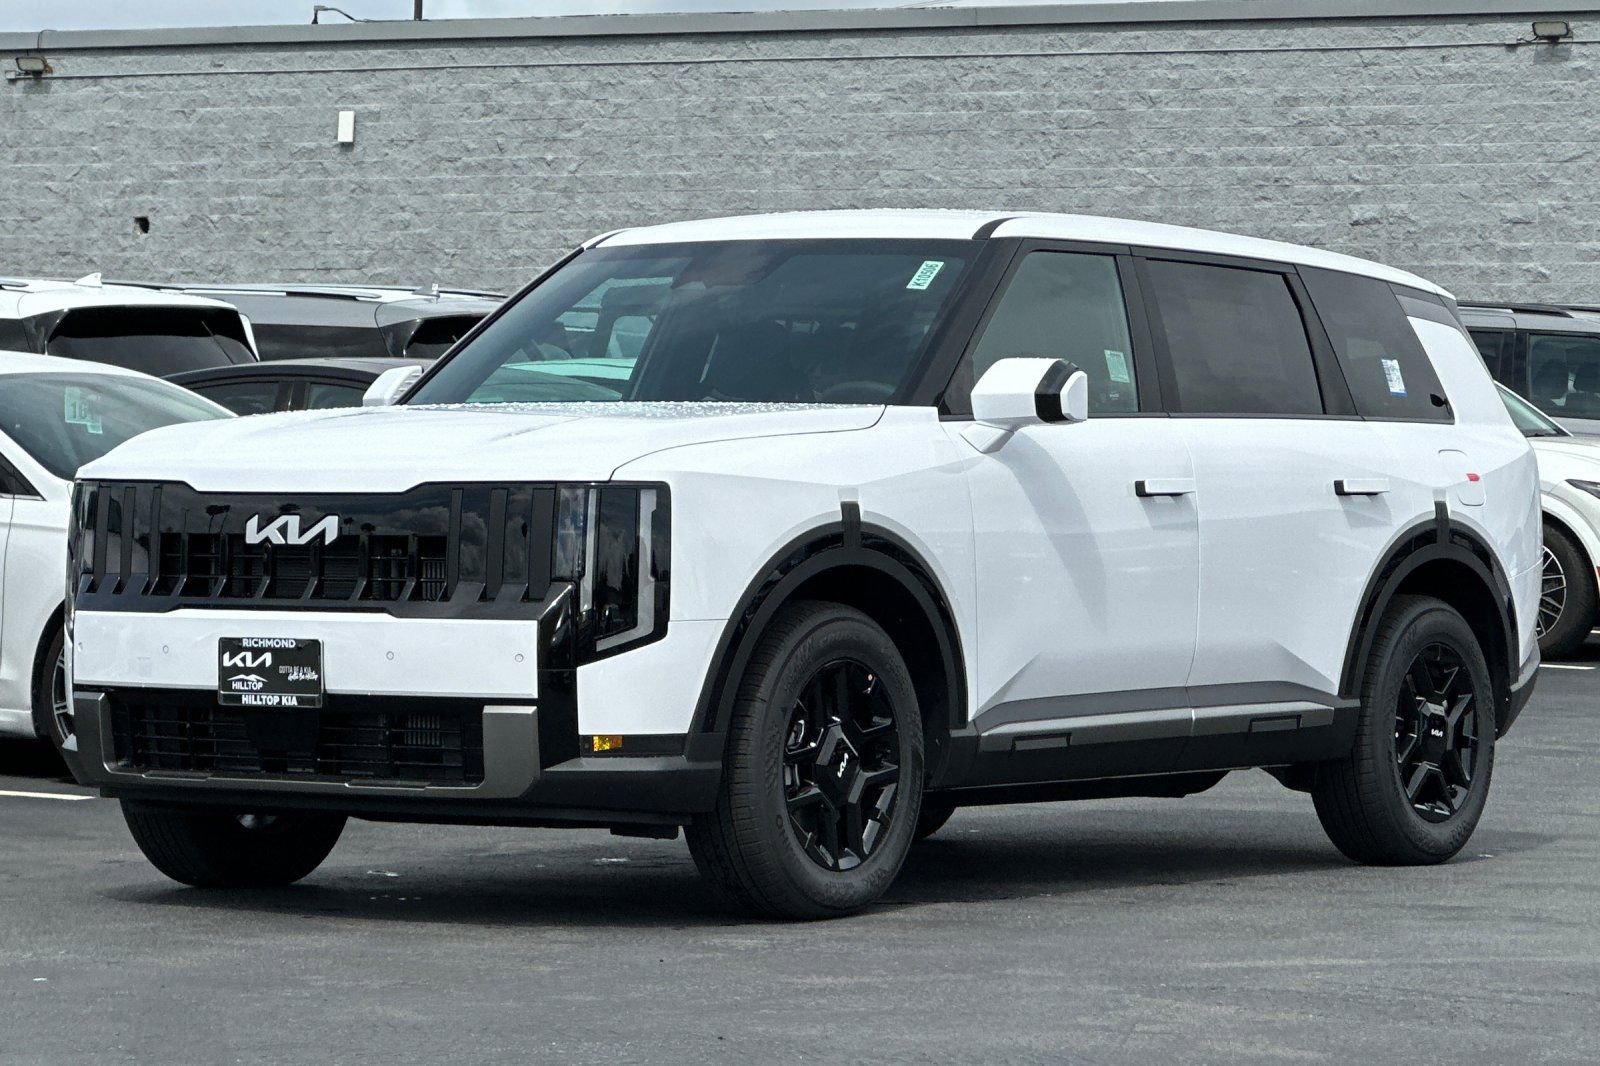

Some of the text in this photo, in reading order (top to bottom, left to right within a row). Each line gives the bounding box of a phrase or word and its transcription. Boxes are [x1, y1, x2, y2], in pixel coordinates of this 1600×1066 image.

[245, 514, 339, 546] KIA
[242, 638, 296, 648] RICHMOND
[223, 651, 272, 667] KIA
[231, 681, 263, 690] HILLTOP
[241, 694, 298, 706] HILLTOP KIA
